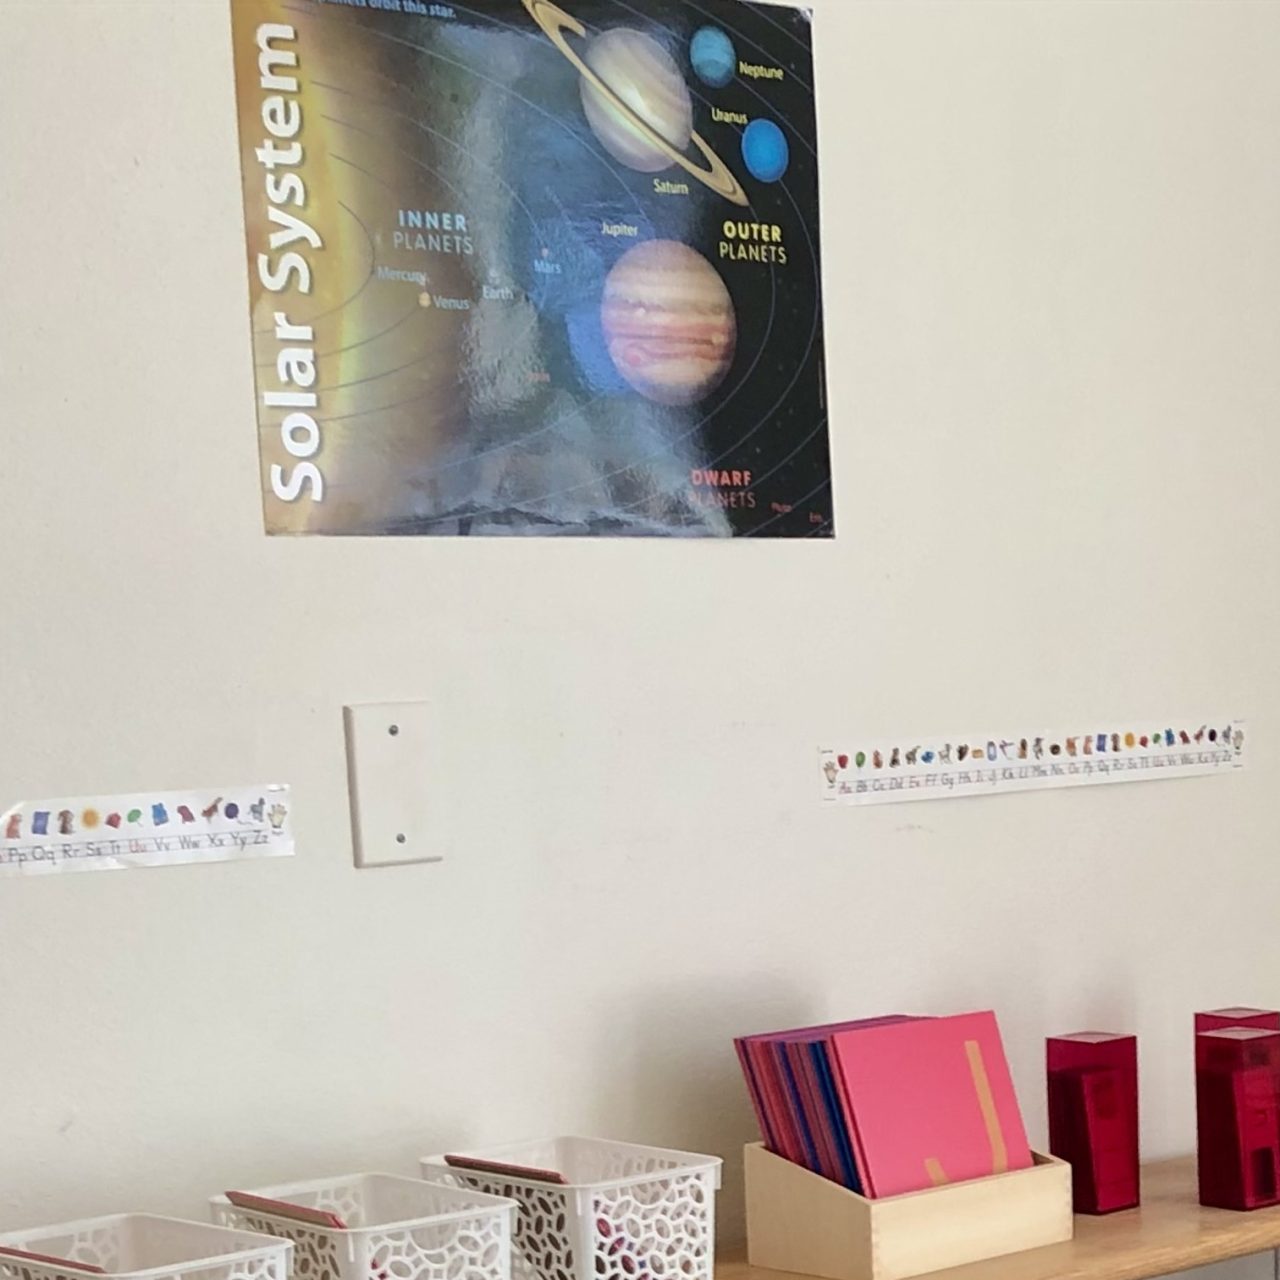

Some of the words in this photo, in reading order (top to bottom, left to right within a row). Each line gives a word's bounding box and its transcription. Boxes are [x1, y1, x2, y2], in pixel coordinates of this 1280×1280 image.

[403, 1, 427, 14] this
[739, 61, 784, 80] Neptune
[712, 107, 748, 124] Uranus
[253, 22, 322, 294] System
[654, 178, 689, 194] Saturn
[399, 210, 467, 232] INNER
[601, 221, 638, 237] Jupiter
[723, 220, 782, 242] OUTER
[393, 231, 474, 255] PLANETS
[719, 242, 786, 264] PLANETS
[377, 266, 427, 286] Mercury
[534, 259, 562, 274] Mars
[433, 295, 470, 310] Venus
[482, 285, 514, 304] Earth
[264, 312, 324, 501] Solar
[691, 469, 752, 486] DWARF
